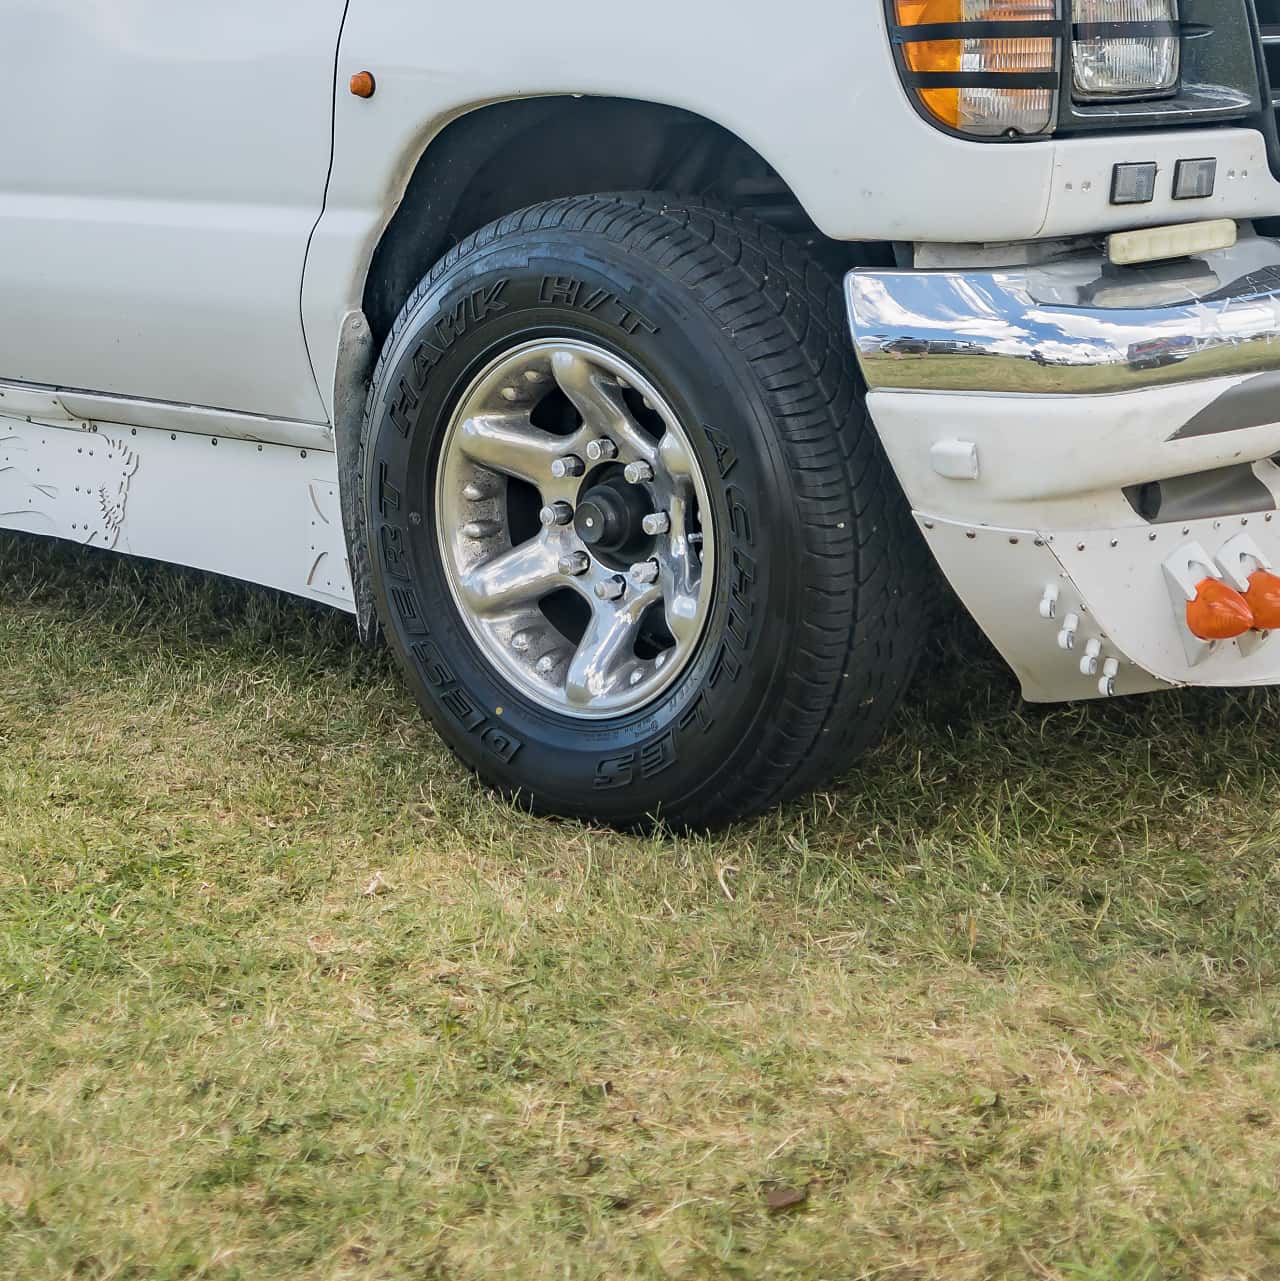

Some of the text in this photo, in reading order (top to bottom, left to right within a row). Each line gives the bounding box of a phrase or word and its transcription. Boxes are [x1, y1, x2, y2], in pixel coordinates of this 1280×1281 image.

[389, 275, 660, 439] HAWK H/T
[378, 461, 524, 765] DESERT
[591, 423, 757, 791] ACHILLES
